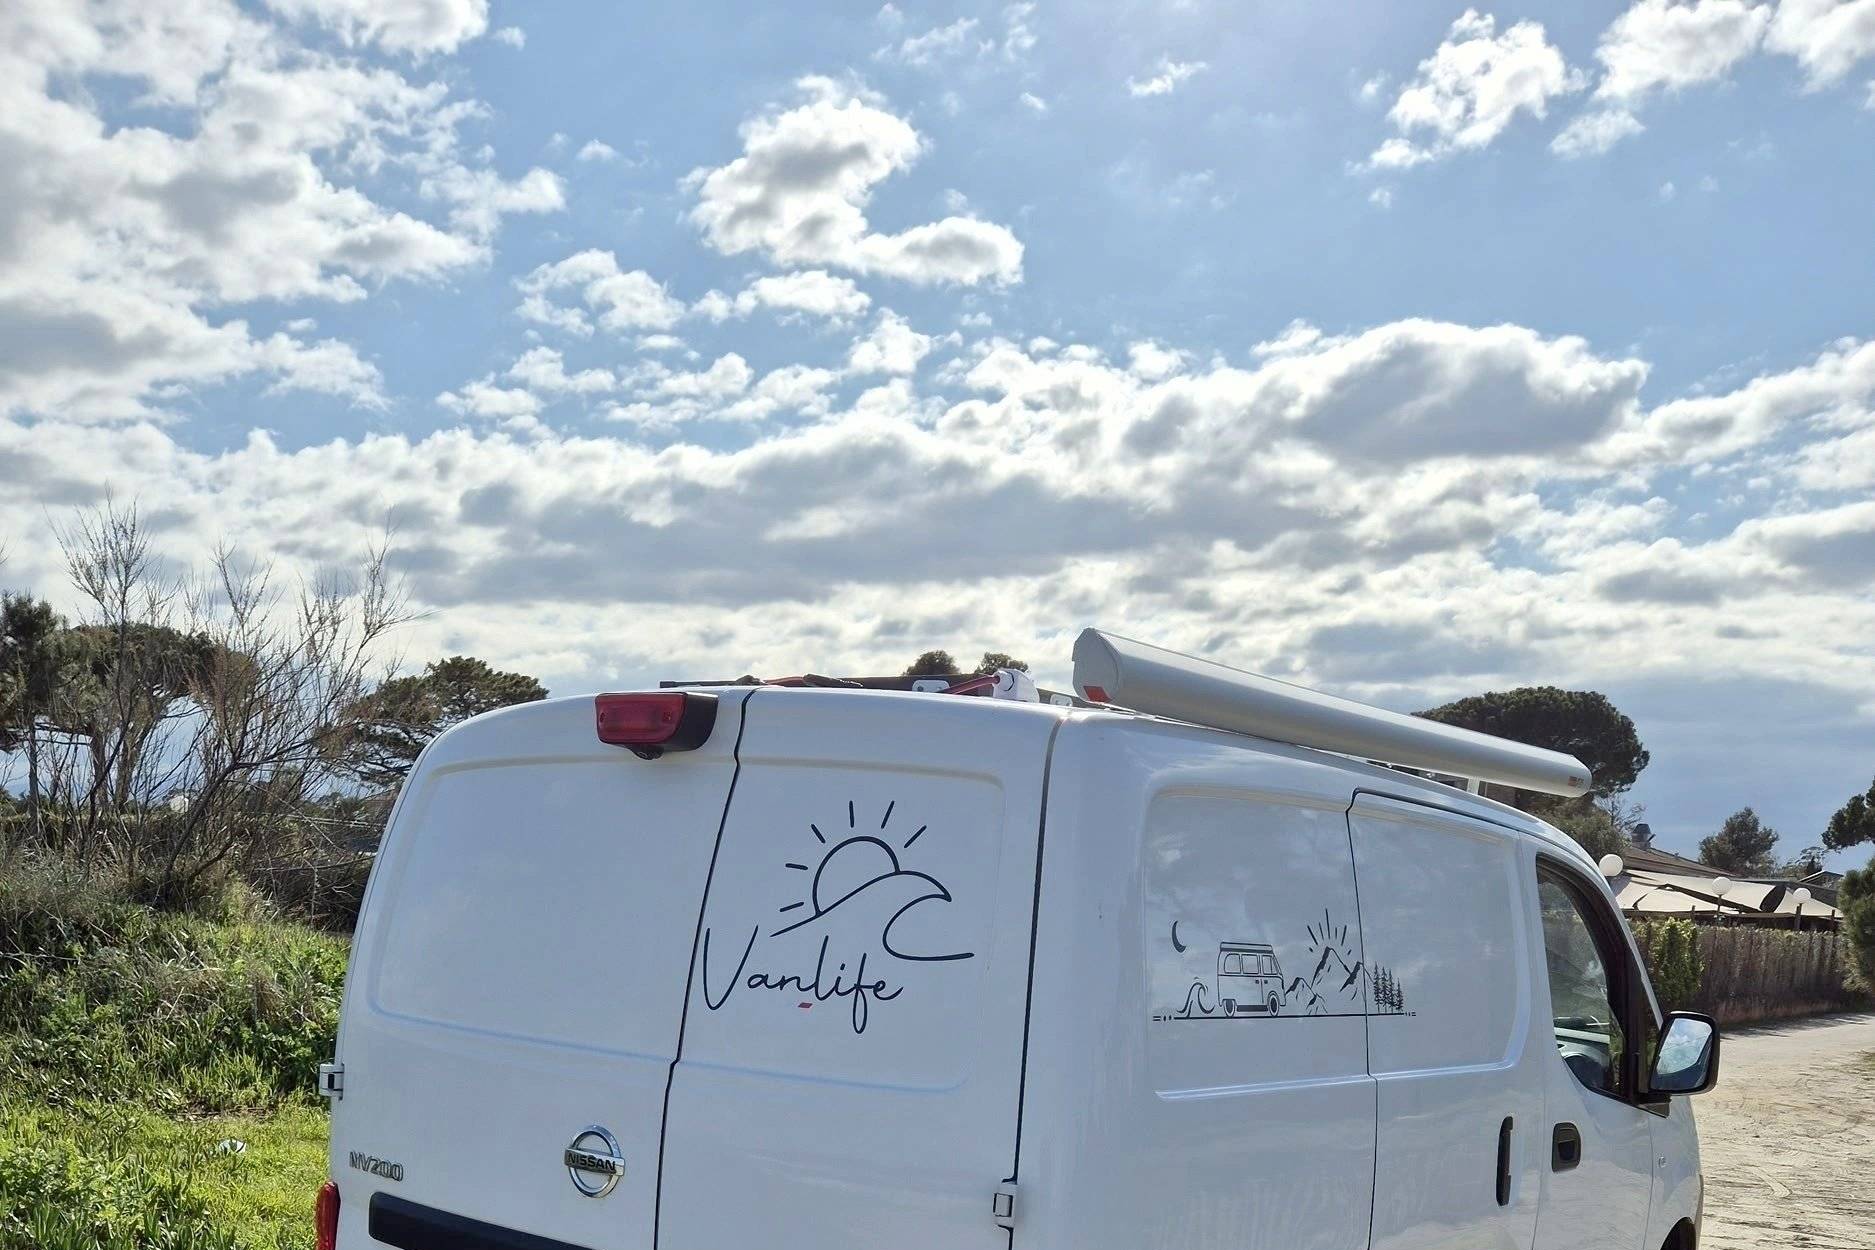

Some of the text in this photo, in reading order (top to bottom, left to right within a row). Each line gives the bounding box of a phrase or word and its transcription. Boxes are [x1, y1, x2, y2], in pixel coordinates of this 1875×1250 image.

[702, 924, 903, 1034] Vanlife
[350, 1151, 404, 1182] NV200
[567, 1152, 616, 1171] NISSAN
